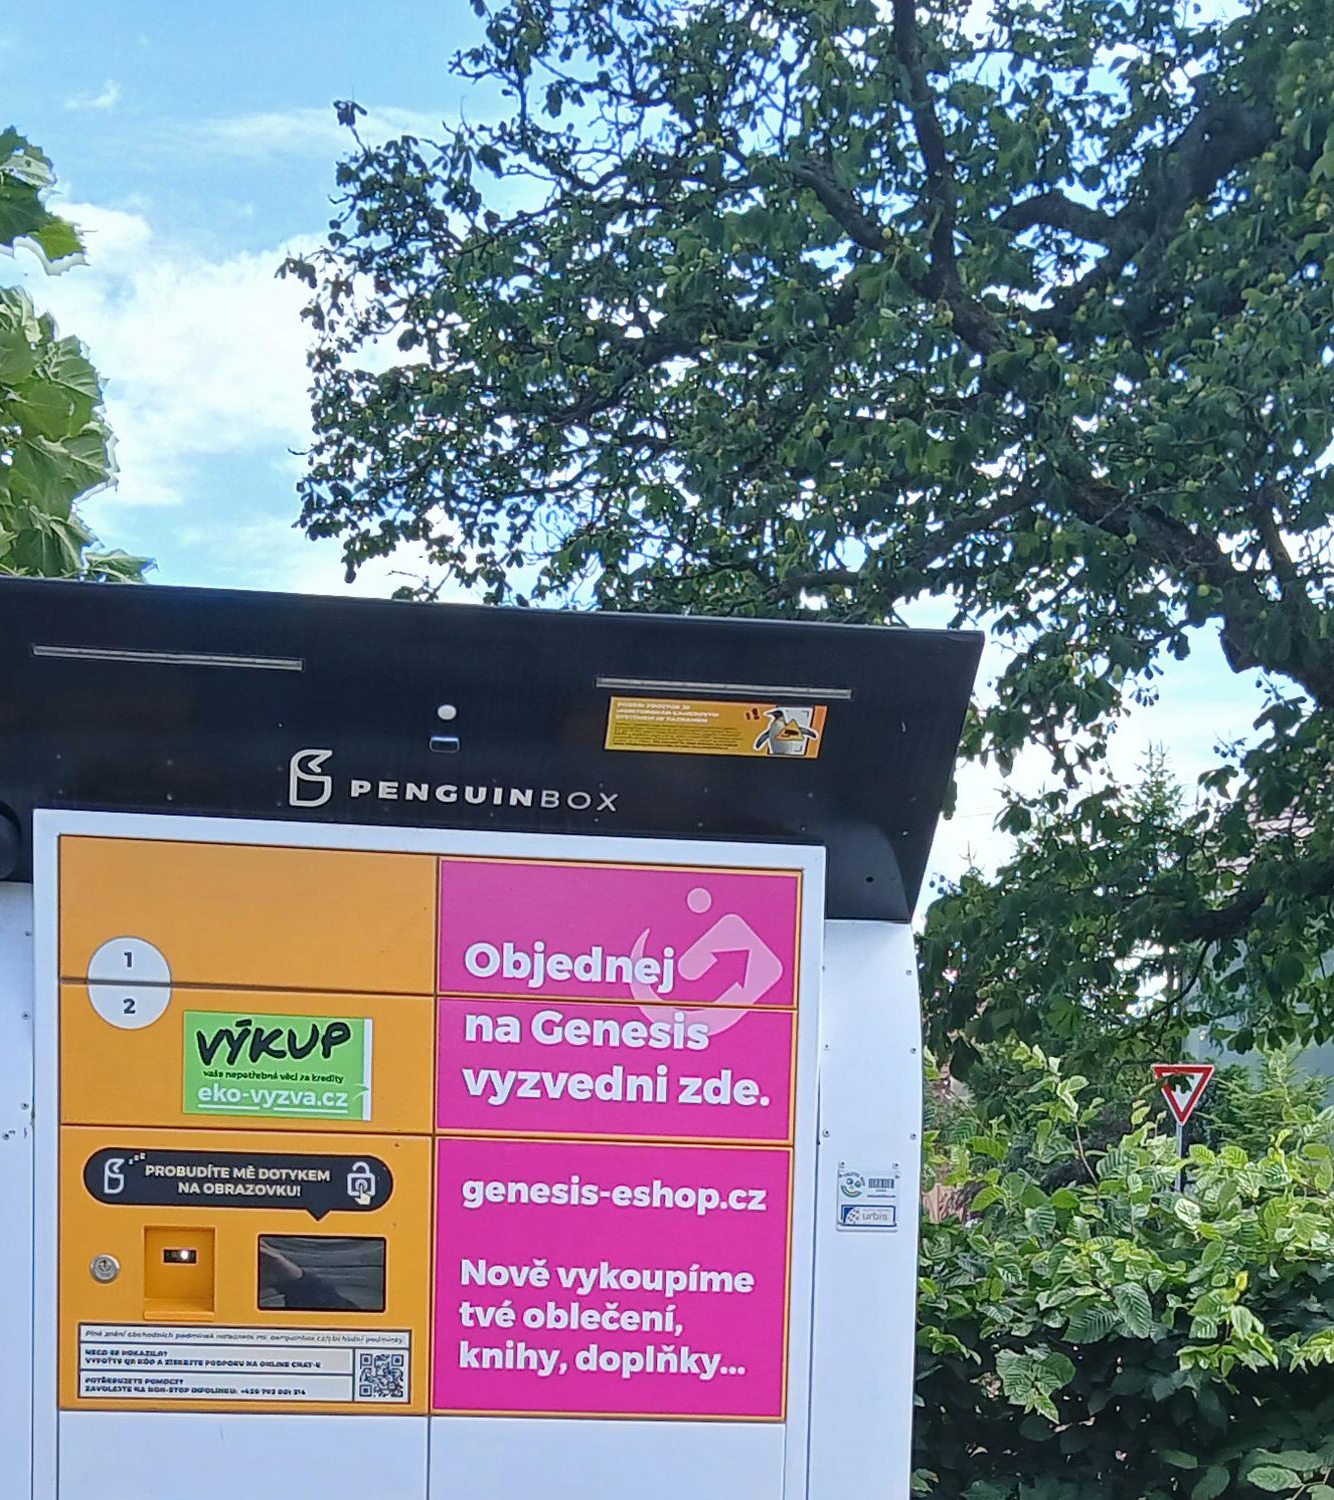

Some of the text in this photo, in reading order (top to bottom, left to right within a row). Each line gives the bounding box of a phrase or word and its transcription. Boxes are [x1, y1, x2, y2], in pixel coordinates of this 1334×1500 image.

[350, 780, 618, 812] PENGUINBOX
[123, 952, 133, 968] 1
[465, 941, 675, 992] Objednej
[123, 999, 136, 1015] 2
[197, 1019, 351, 1066] VÝKUP
[465, 1010, 709, 1051] na Genesis
[198, 1083, 348, 1108] eko-vyzva.cz
[312, 1074, 343, 1083] kredity
[463, 1065, 770, 1107] vyzvedni zde.
[145, 1162, 330, 1182] PROBUDÍTE MĚ DOTYKEM
[178, 1182, 301, 1197] NA OBRAZOVKU!
[462, 1176, 767, 1215] genesis-eshop.cz
[460, 1257, 754, 1297] Nově vykoupíme
[460, 1300, 683, 1337] tvé oblečení,
[459, 1341, 745, 1381] knihy, doplňky...
